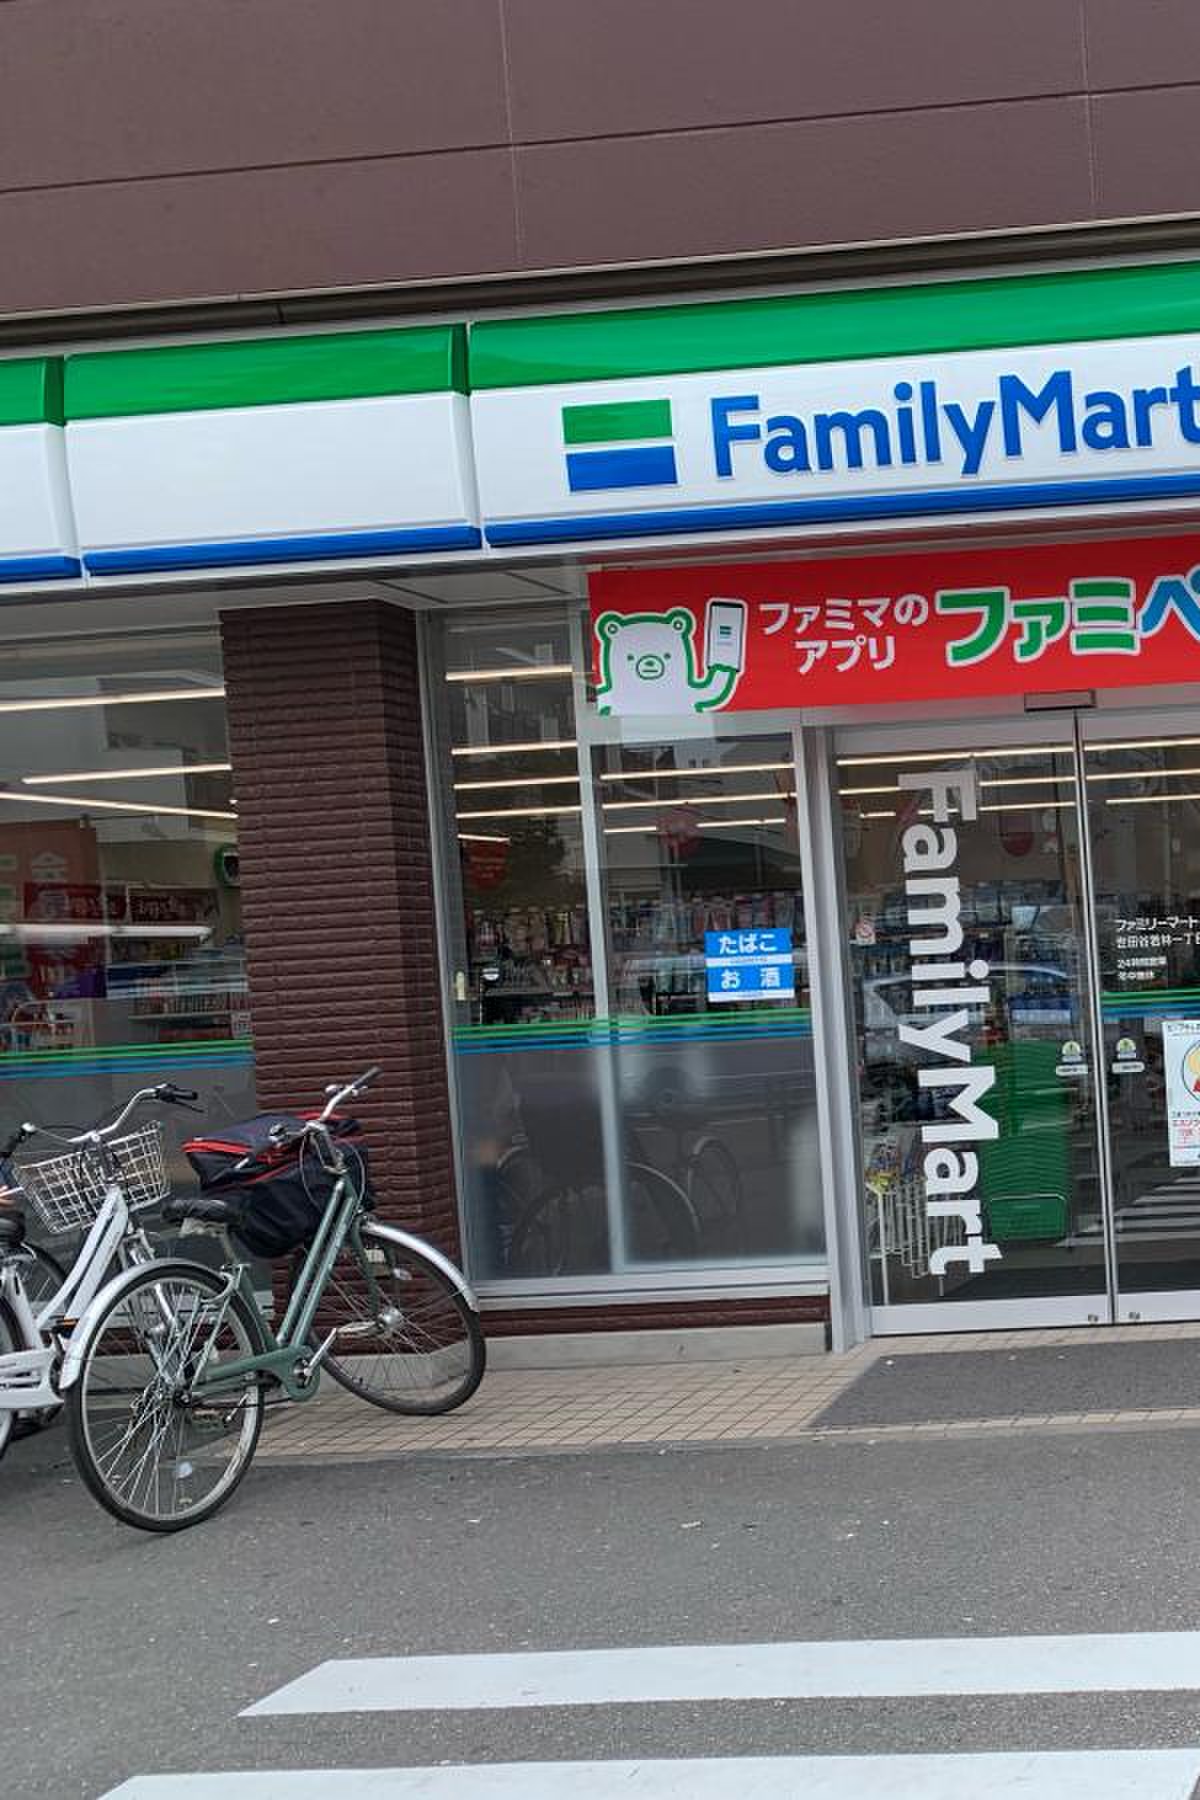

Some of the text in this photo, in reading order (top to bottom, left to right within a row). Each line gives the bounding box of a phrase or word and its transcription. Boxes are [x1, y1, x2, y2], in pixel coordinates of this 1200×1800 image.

[759, 594, 929, 635] ファミマの
[794, 634, 896, 674] アプリ
[718, 933, 777, 955] たばこ
[1115, 916, 1200, 933] ファミリーマート
[897, 768, 1003, 1277] FamilyMart
